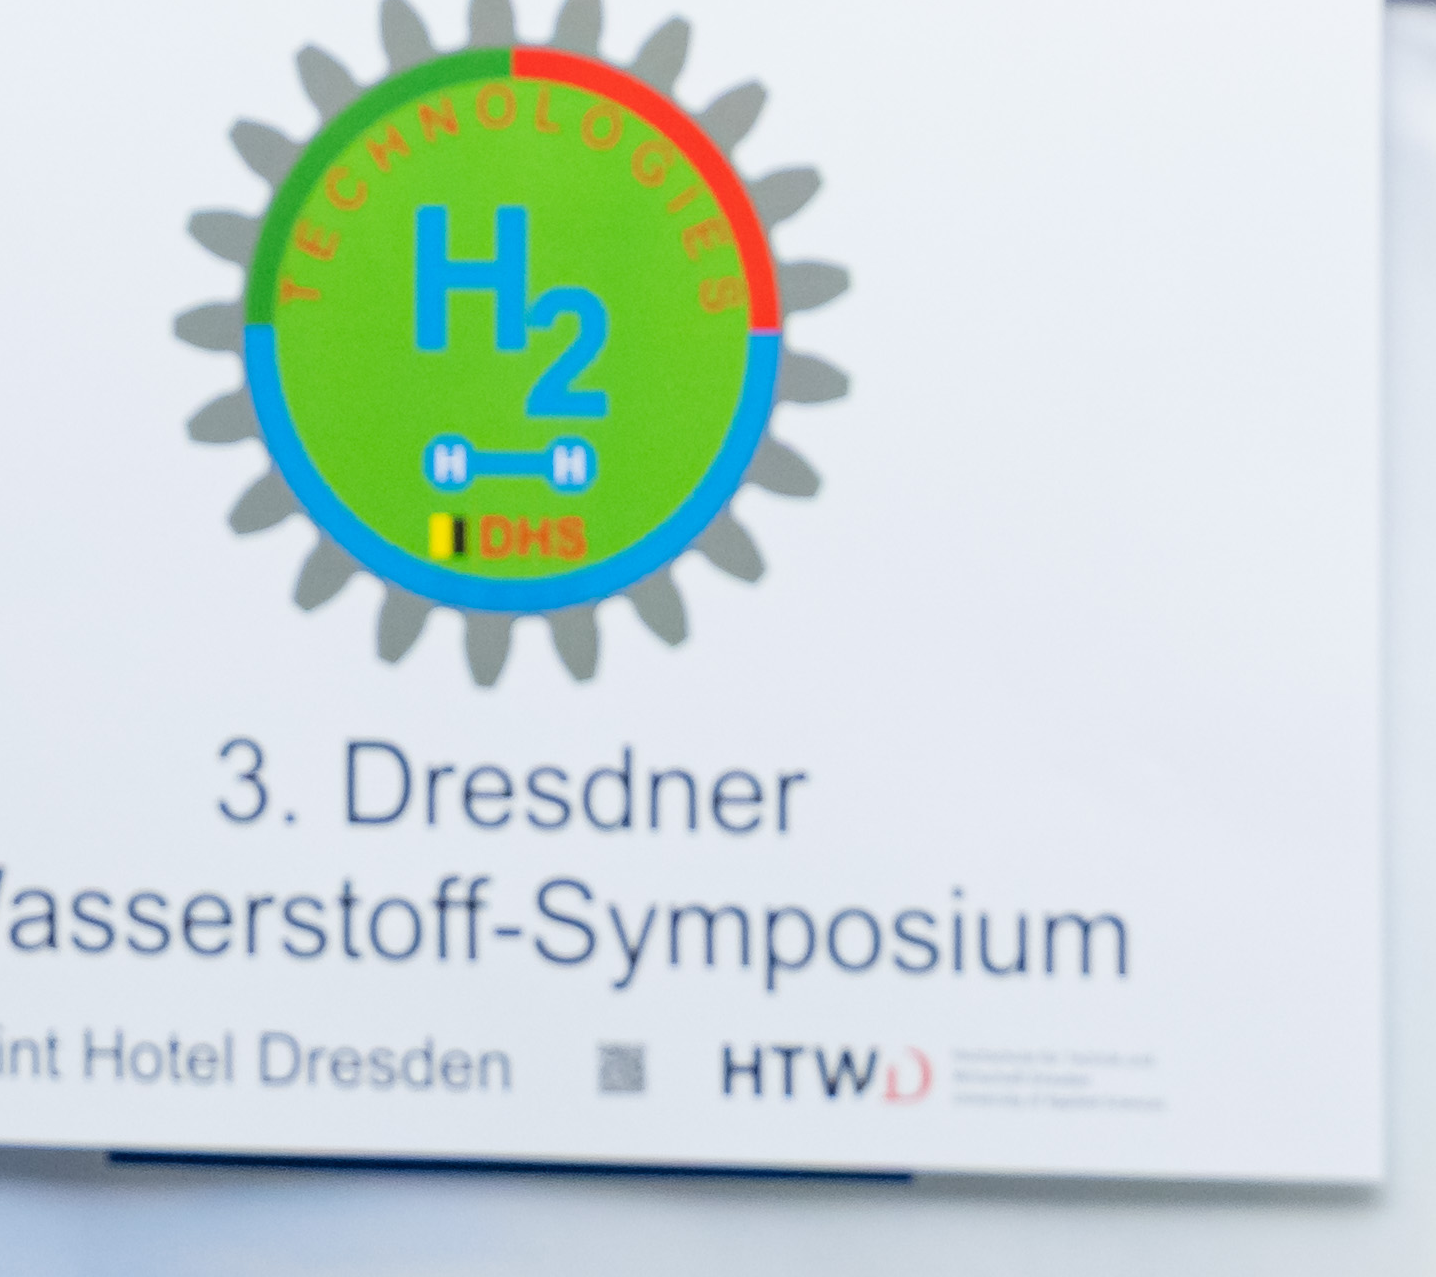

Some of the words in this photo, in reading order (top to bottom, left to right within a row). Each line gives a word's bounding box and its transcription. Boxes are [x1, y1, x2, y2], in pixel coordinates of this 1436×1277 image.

[277, 82, 750, 315] TECHNOLOGIES
[432, 442, 469, 486] H
[551, 443, 588, 487] H
[477, 512, 590, 562] DHS
[214, 735, 299, 828] 3.
[343, 737, 810, 837] Dresdner
[80, 1026, 236, 1088] Hotel
[256, 1029, 515, 1094] Dresden
